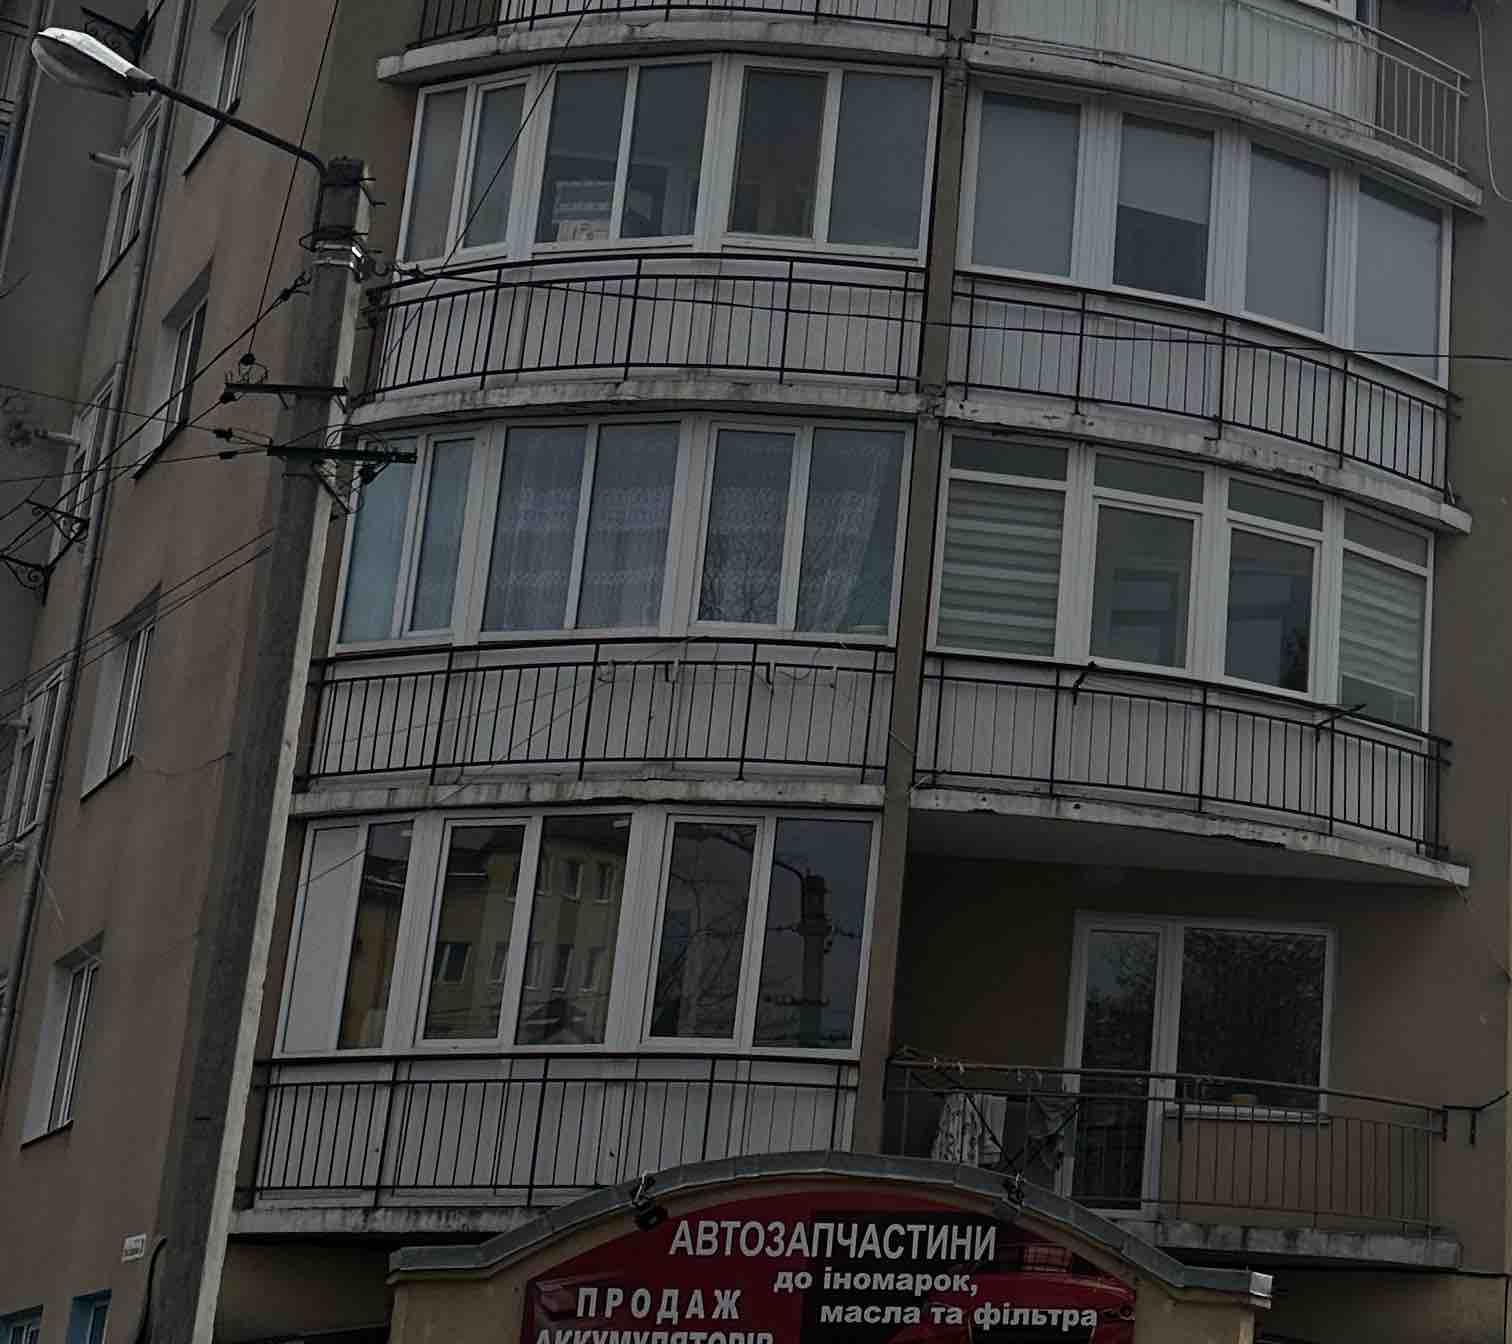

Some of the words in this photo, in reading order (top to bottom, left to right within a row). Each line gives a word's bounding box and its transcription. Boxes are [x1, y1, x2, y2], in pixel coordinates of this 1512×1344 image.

[669, 1219, 998, 1262] АВТОЗАПЧАСТИНИ
[773, 1270, 814, 1294] до
[823, 1266, 979, 1297] іномарок,
[576, 1287, 742, 1326] ПРОДАЖ
[820, 1304, 921, 1326] масла
[928, 1306, 964, 1326] та
[973, 1301, 1098, 1332] фільтра
